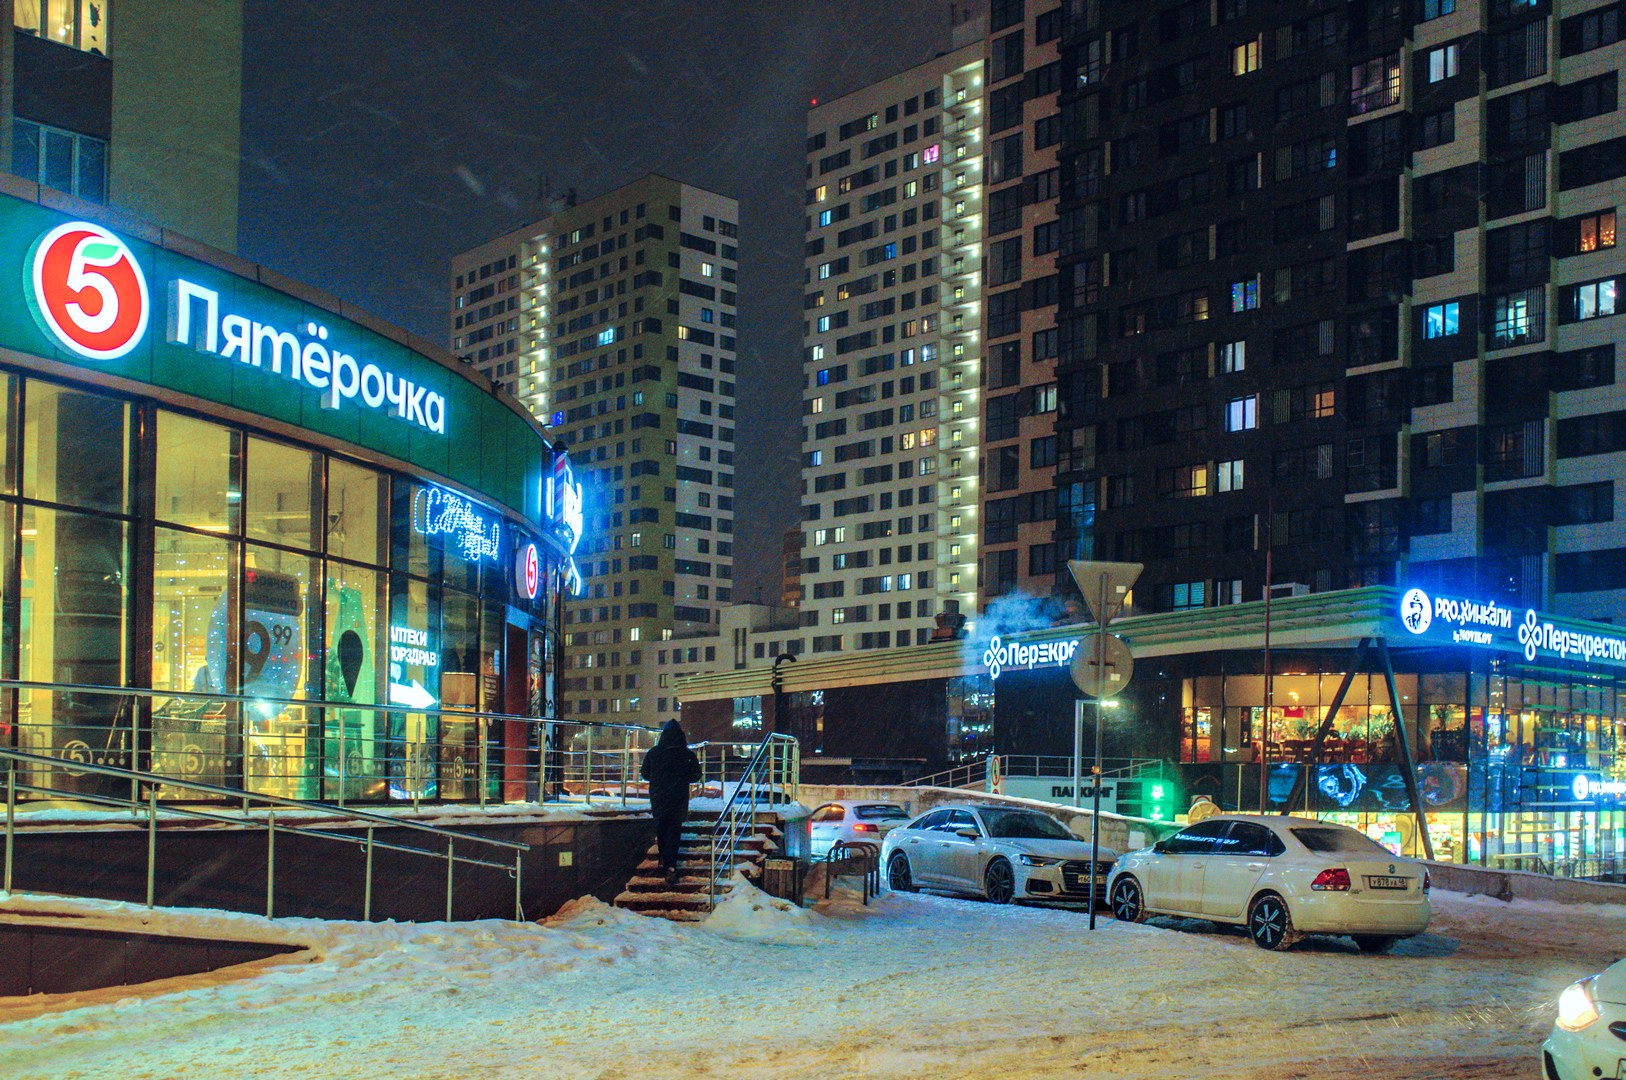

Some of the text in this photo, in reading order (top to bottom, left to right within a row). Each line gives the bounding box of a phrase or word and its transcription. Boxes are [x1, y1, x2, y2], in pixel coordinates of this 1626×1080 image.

[65, 236, 124, 334] 5
[177, 278, 445, 435] Пятёрочка
[273, 624, 292, 646] 99
[391, 645, 437, 666] ОРЗДРАВ
